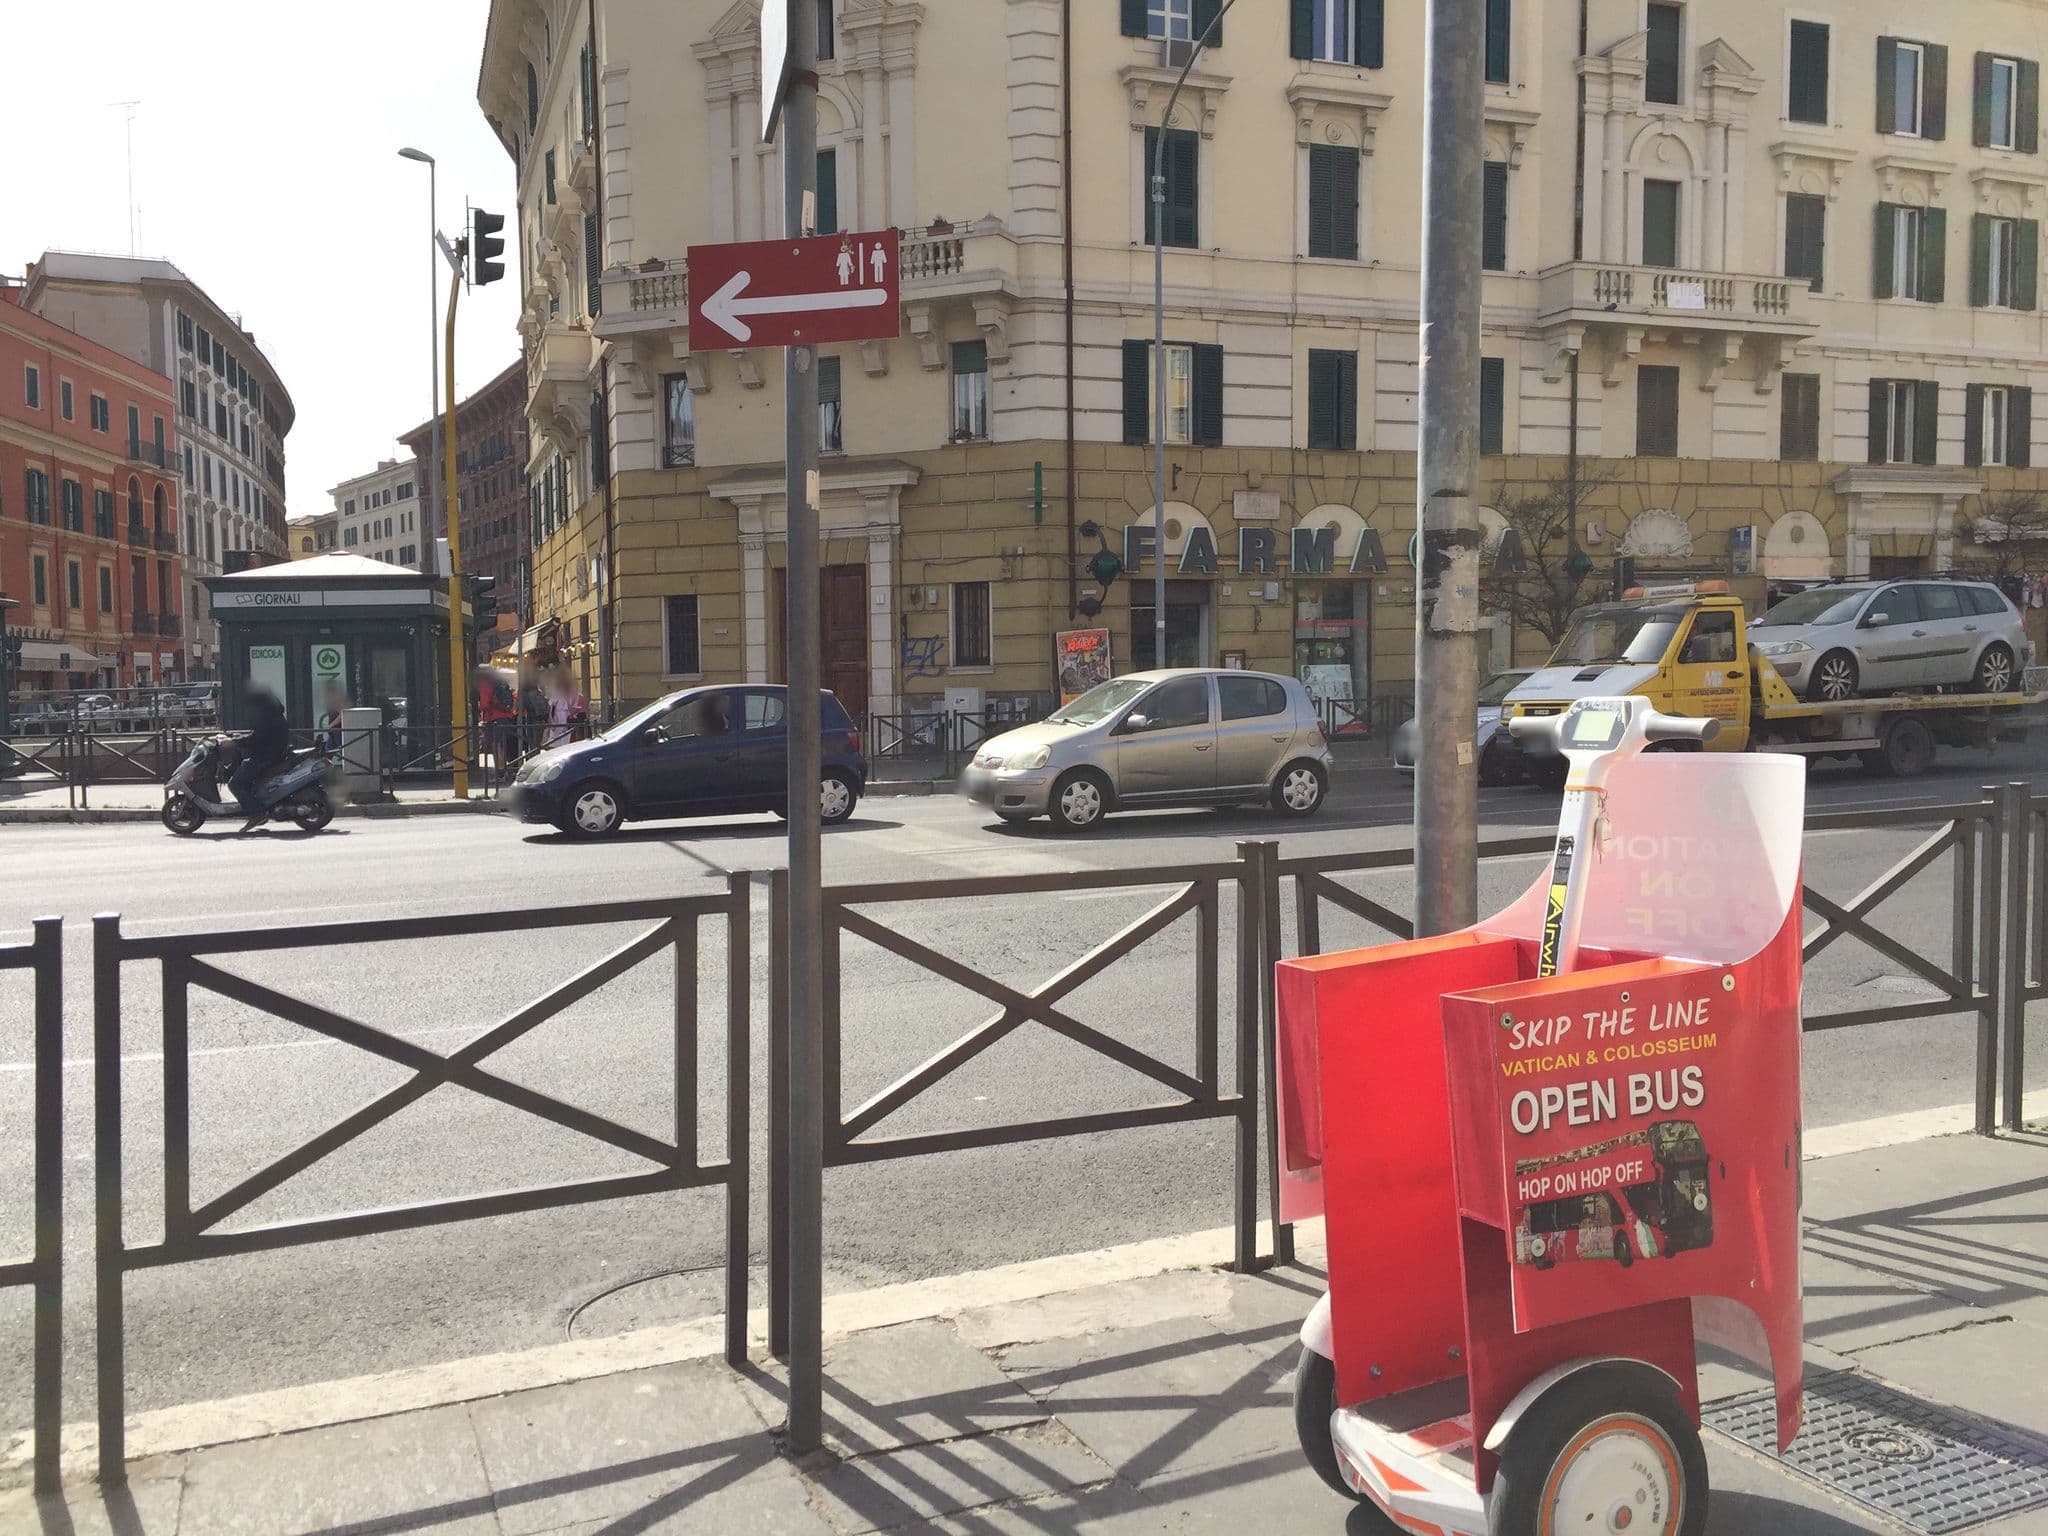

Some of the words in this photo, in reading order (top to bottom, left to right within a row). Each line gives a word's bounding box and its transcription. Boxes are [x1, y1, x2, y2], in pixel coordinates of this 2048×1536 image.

[1123, 525, 1528, 573] FARMAA
[254, 594, 301, 606] GIORNALI
[251, 649, 282, 660] EDICOLA
[1508, 1015, 1572, 1050] SKIP
[1583, 1005, 1636, 1039] THE
[1649, 997, 1711, 1031] LINE
[1501, 1052, 1580, 1077] VATICAN
[1586, 1050, 1598, 1065] &
[1604, 1033, 1717, 1062] COLOSSEUM
[1510, 1079, 1616, 1134] OPEN
[1629, 1066, 1705, 1115] BUS
[1519, 1177, 1549, 1201] HOP
[1555, 1173, 1577, 1194] ON
[1581, 1166, 1611, 1190] HOP
[1616, 1160, 1643, 1183] OFF
